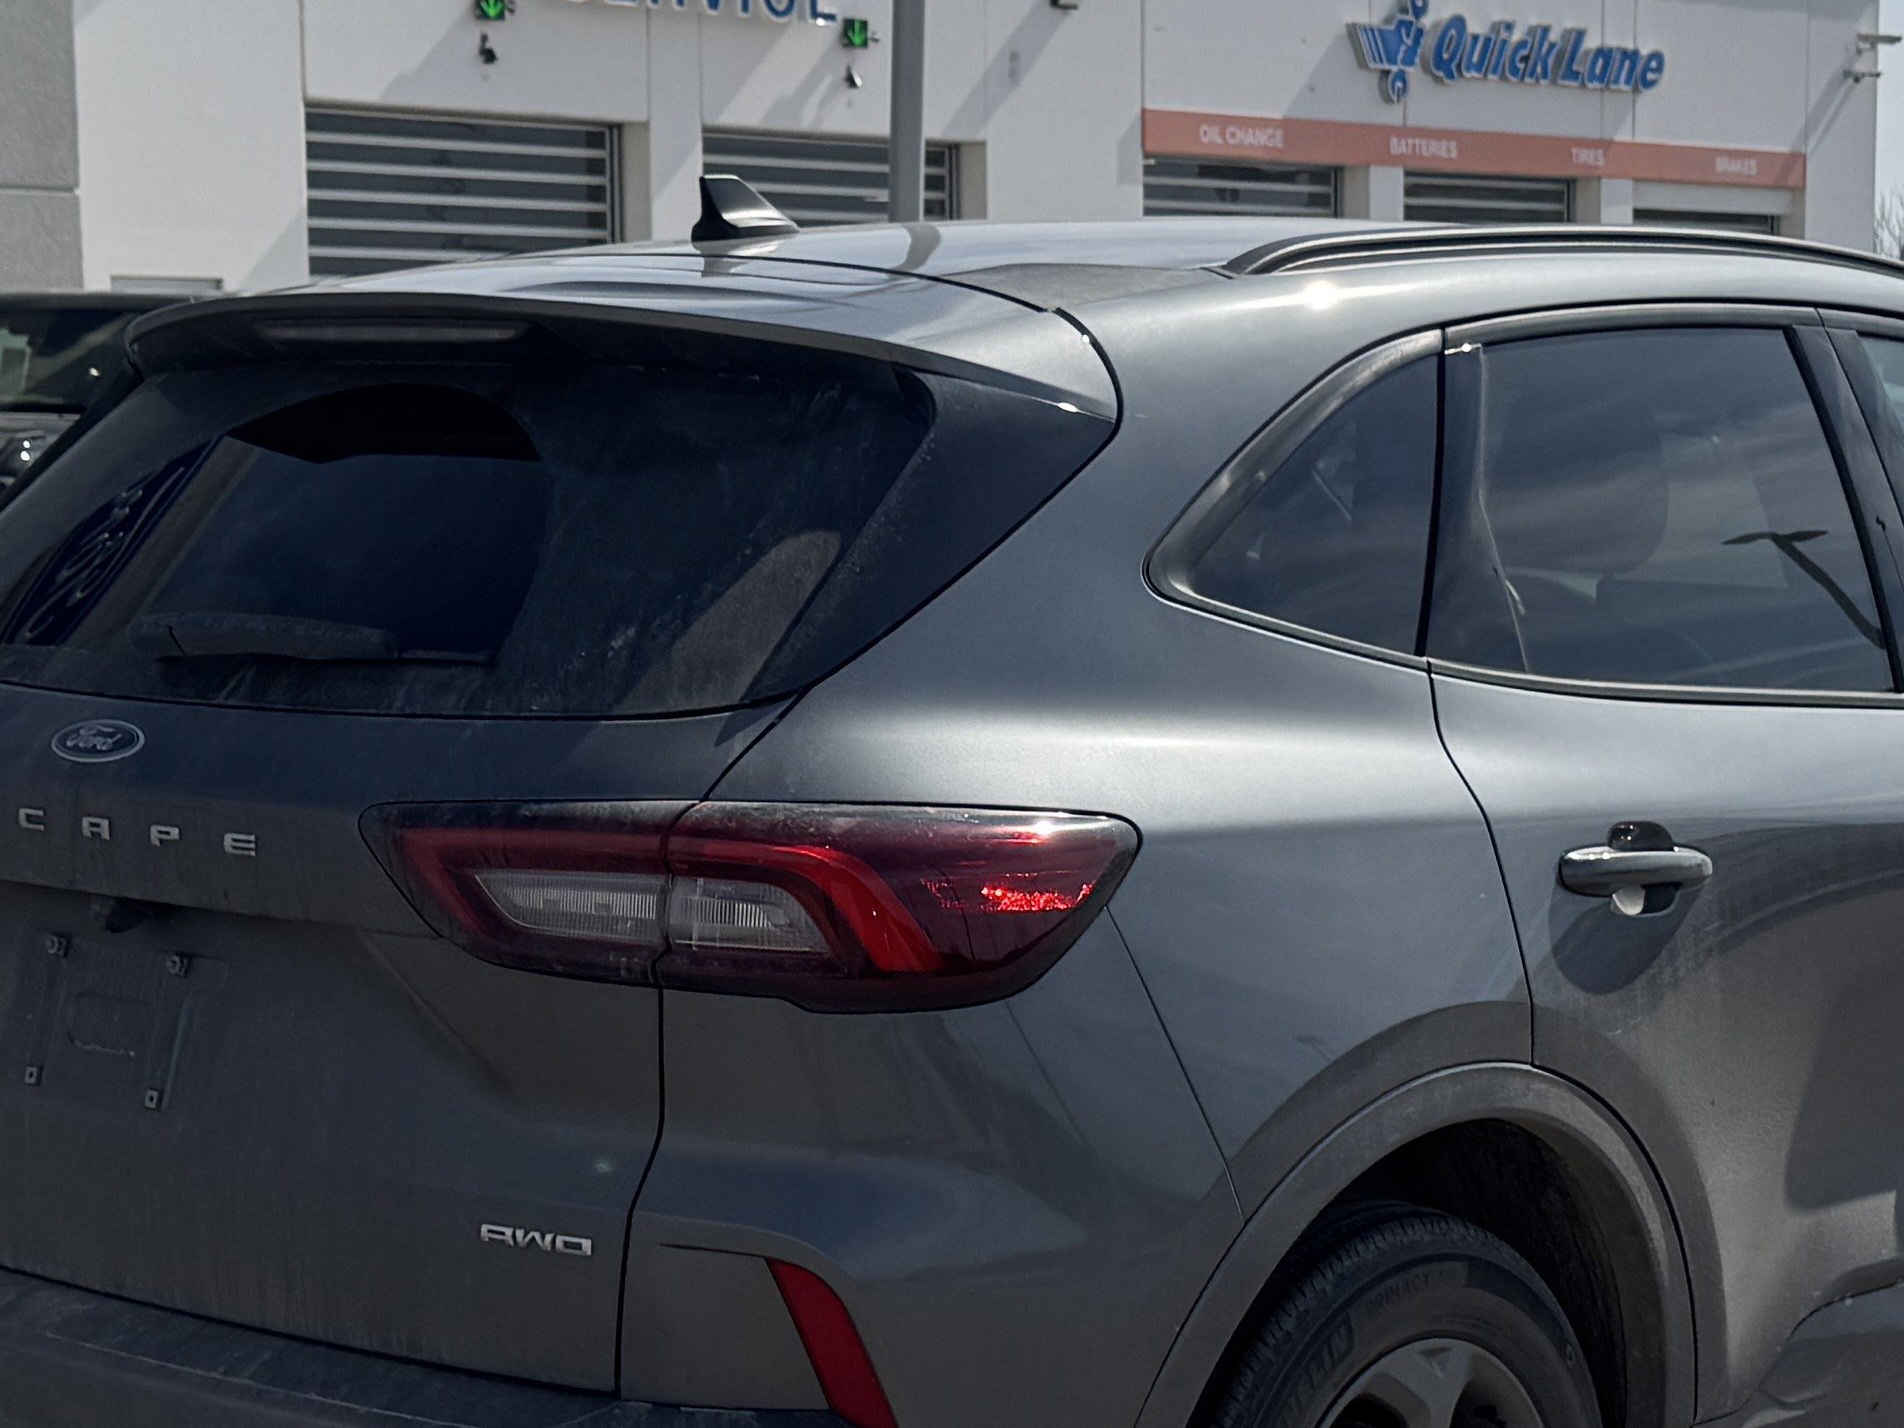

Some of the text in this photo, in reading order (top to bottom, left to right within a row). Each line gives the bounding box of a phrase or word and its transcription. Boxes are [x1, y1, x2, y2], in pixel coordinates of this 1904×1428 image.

[1199, 123, 1284, 149] OIL CHANGE
[1389, 136, 1458, 160] BATTERIES
[1571, 146, 1605, 167] TIRES
[1715, 154, 1758, 176] BRAKES
[480, 1223, 592, 1256] AWD
